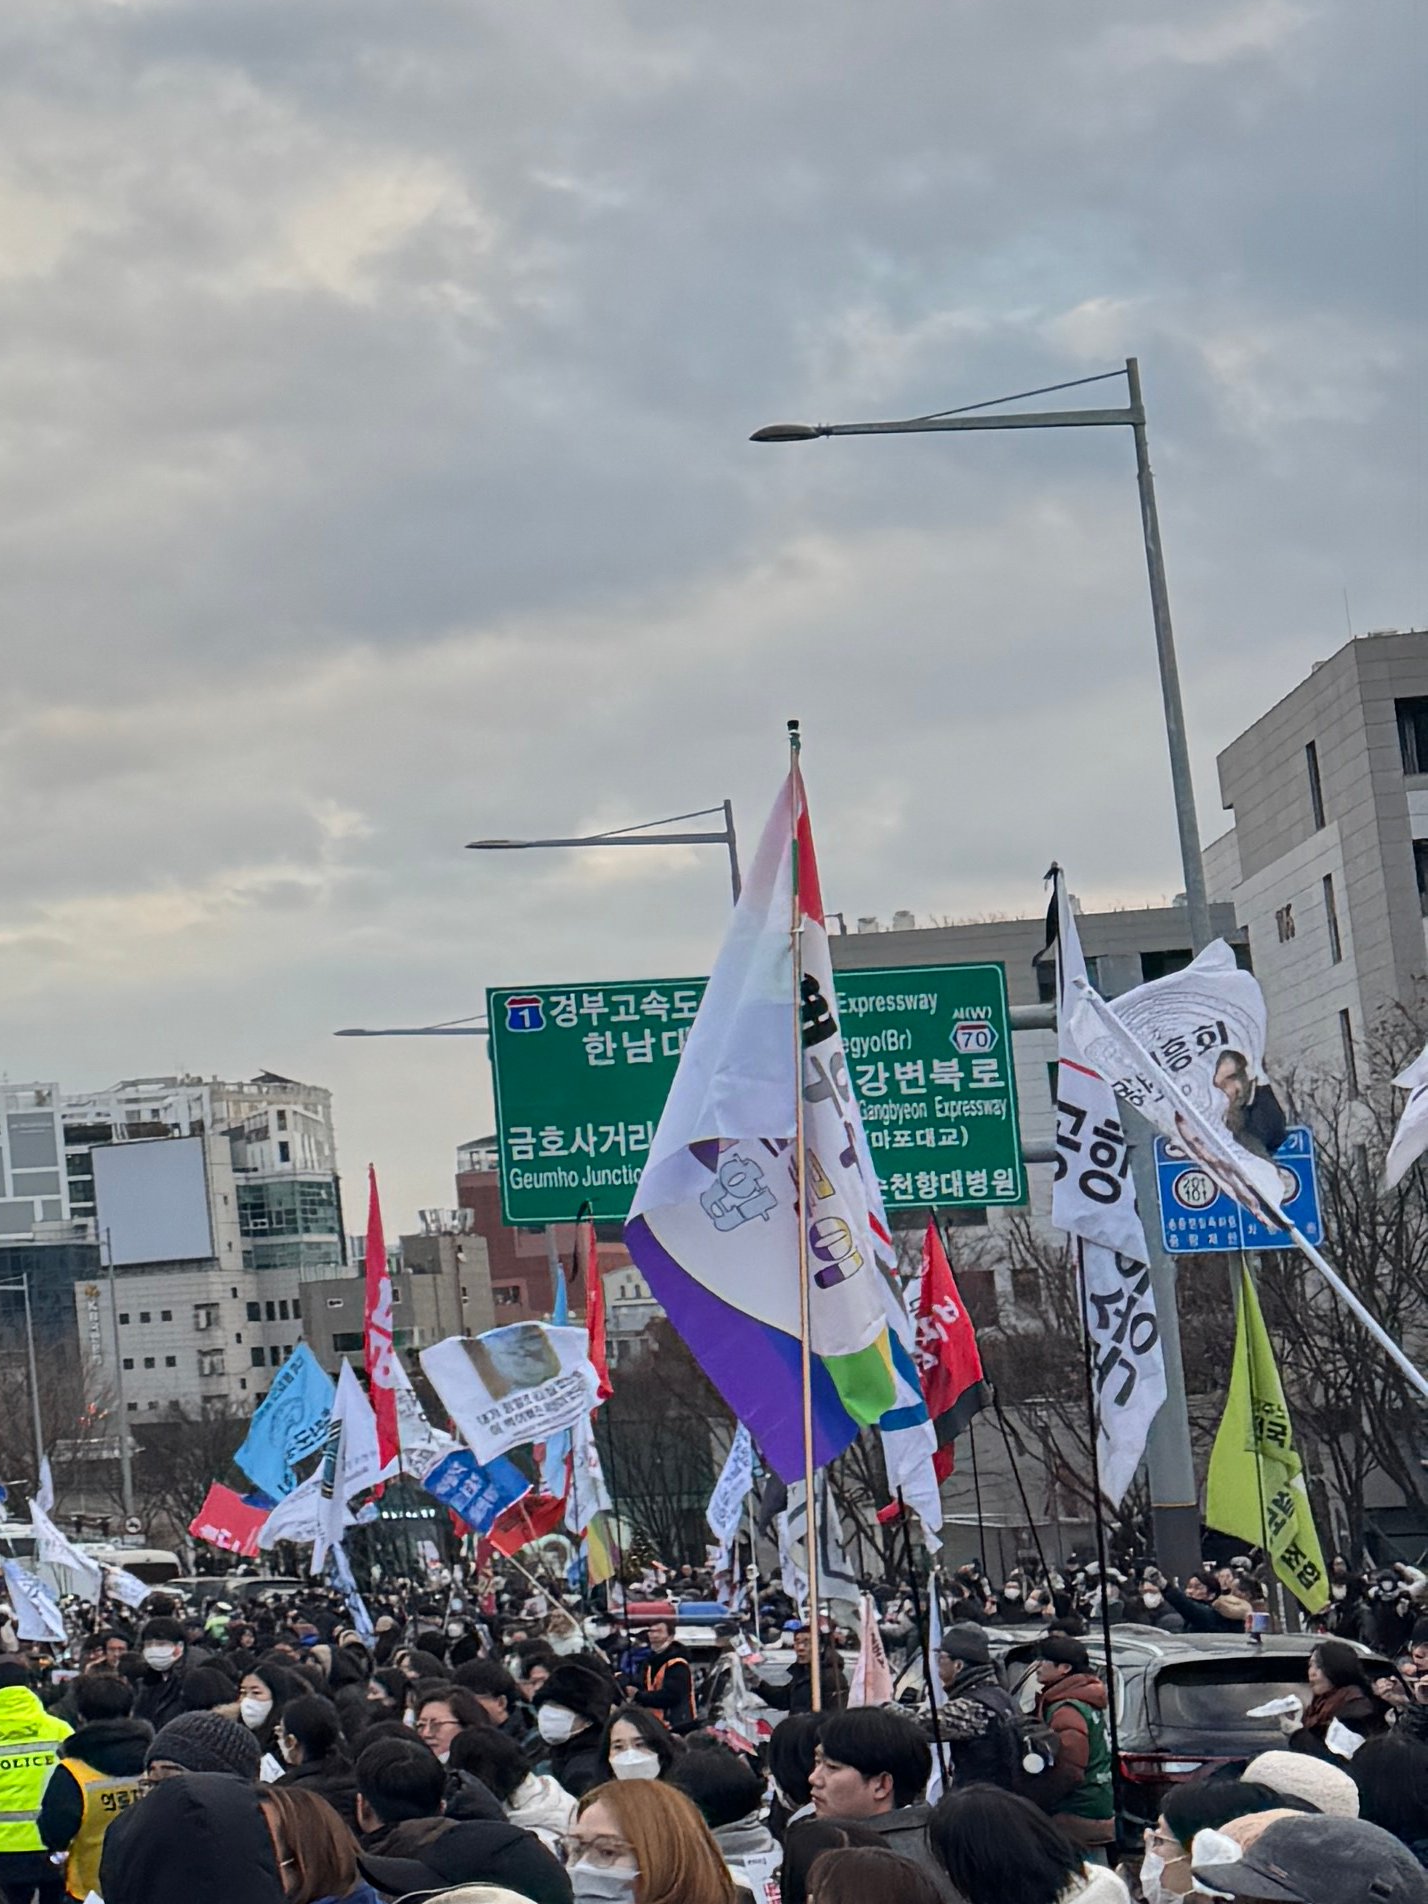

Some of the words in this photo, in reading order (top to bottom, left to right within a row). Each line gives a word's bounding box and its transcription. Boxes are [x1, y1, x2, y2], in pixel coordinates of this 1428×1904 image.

[549, 990, 698, 1028] 경부고속도
[837, 992, 937, 1016] Expressway
[518, 1009, 531, 1027] 1
[961, 1031, 989, 1048] 70
[856, 1057, 1005, 1097] 강변북로
[858, 1098, 927, 1125] Gangbyeon
[935, 1096, 1007, 1120] Expressway
[508, 1121, 654, 1161] 금호사거리
[509, 1166, 579, 1190] Geumho
